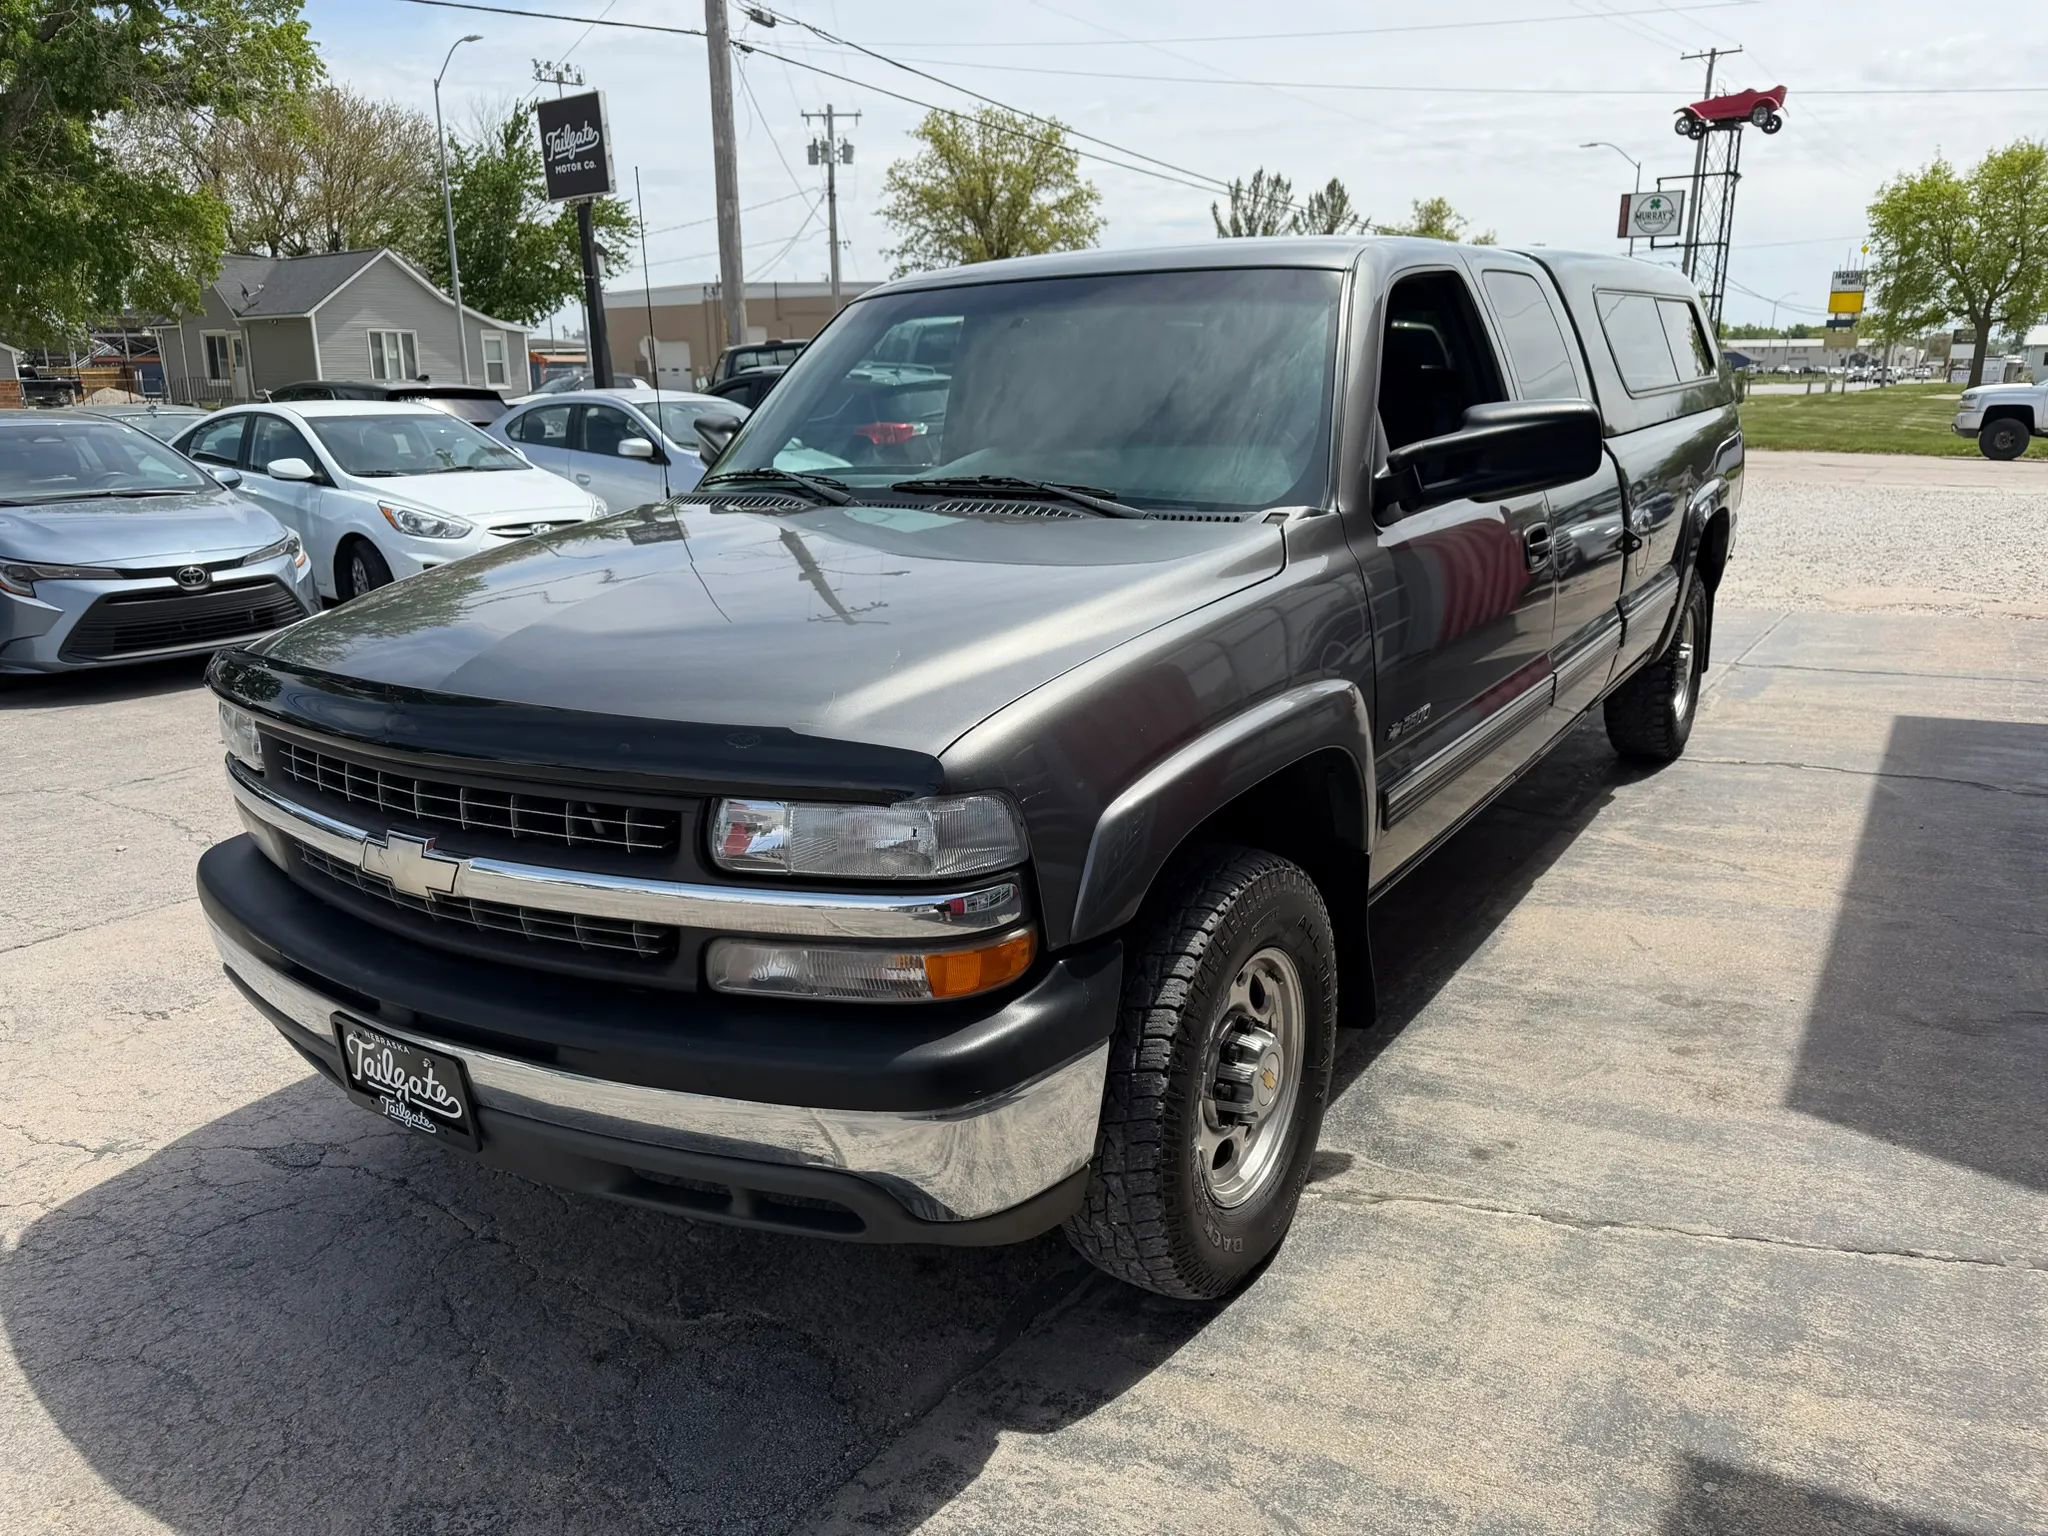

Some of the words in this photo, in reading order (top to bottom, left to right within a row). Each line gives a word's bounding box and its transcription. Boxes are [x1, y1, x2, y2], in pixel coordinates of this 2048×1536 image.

[546, 120, 599, 162] Tailgate
[555, 163, 582, 174] MOTOR
[1296, 914, 1320, 953] ALL
[364, 1030, 410, 1054] NEBRASKA
[346, 1032, 463, 1119] Tailgate
[379, 1094, 437, 1134] Tailgate
